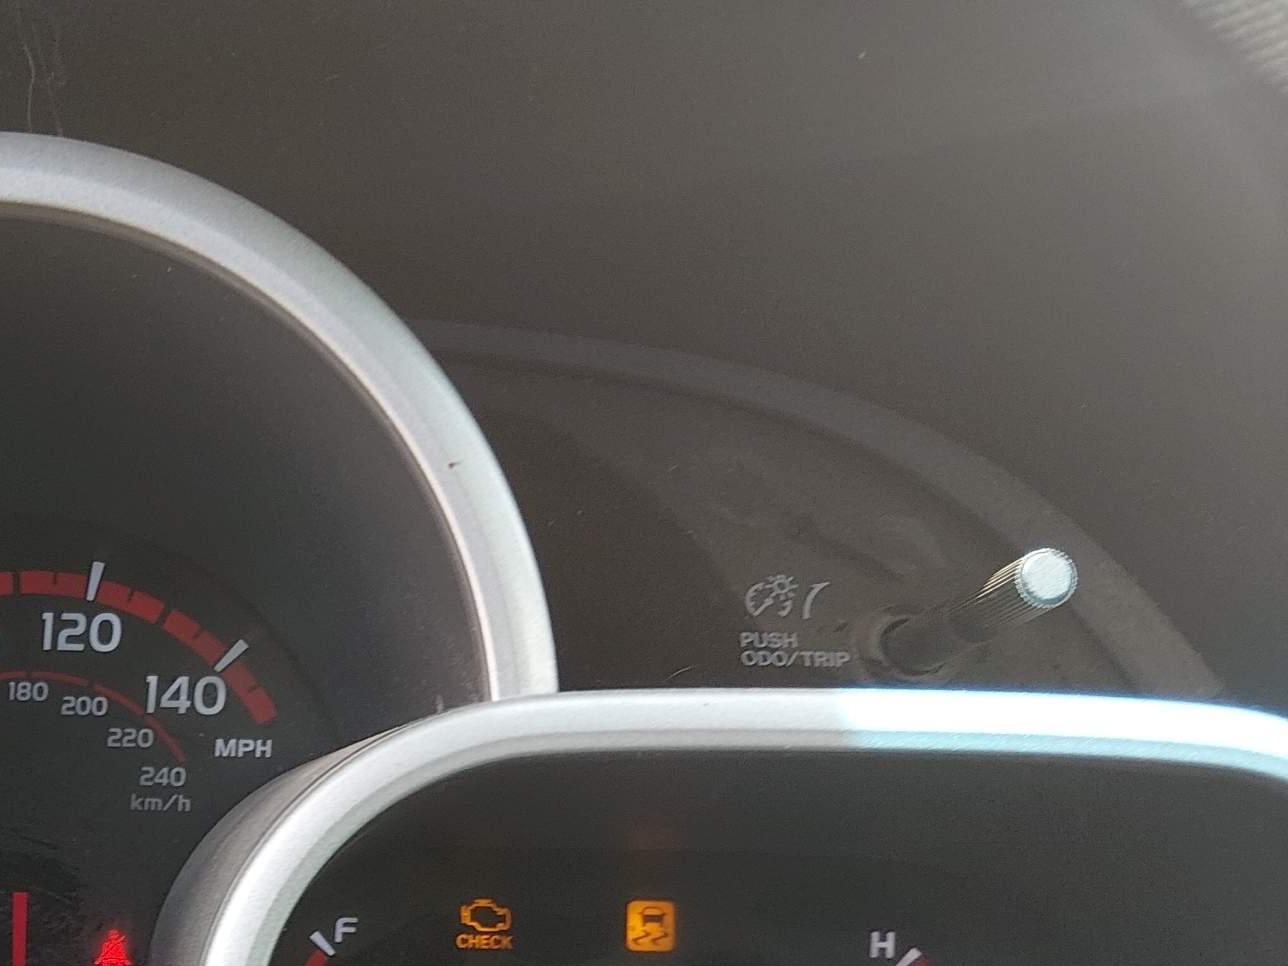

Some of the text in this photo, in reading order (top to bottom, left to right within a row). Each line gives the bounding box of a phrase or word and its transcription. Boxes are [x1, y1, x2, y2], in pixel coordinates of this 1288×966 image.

[41, 612, 122, 653] 120
[740, 632, 799, 649] PUSH
[740, 651, 851, 668] ODO/TRIP
[9, 681, 49, 702] 180
[145, 674, 227, 716] 140
[61, 697, 108, 717] 200
[107, 729, 154, 749] 220
[215, 738, 273, 759] MPH
[140, 767, 186, 788] 240
[130, 794, 191, 813] km/h
[335, 916, 359, 943] F
[456, 934, 514, 949] CHECK
[869, 931, 896, 958] H
